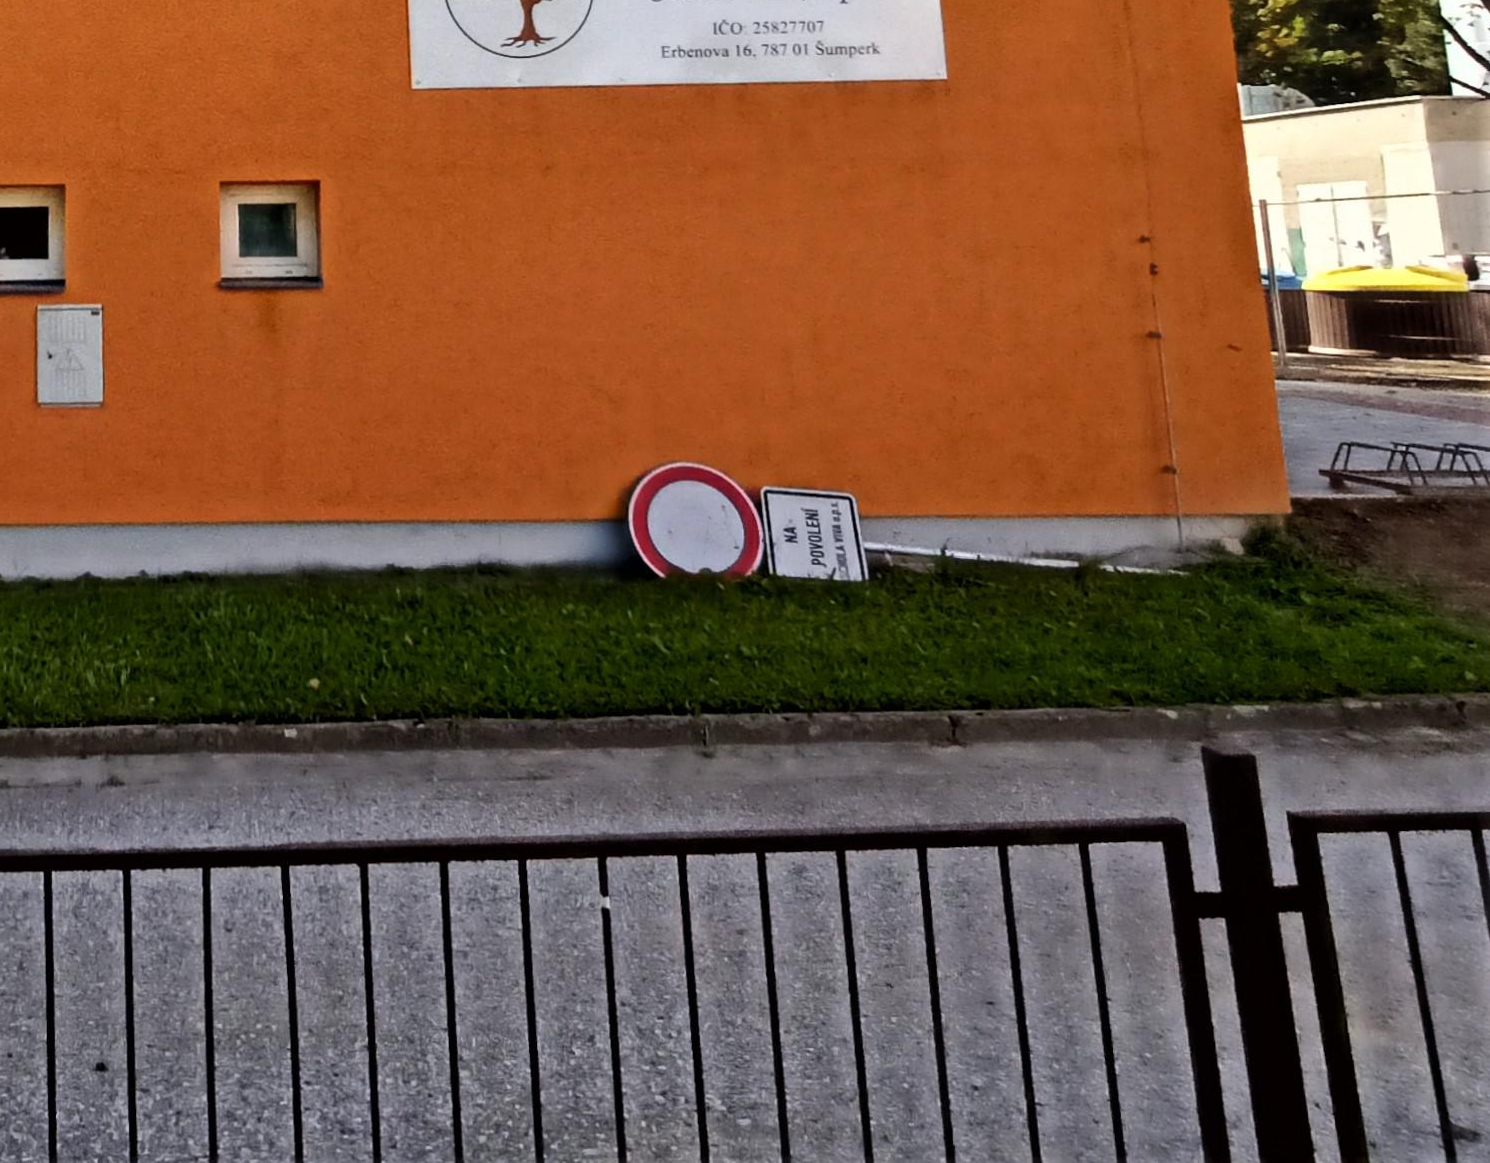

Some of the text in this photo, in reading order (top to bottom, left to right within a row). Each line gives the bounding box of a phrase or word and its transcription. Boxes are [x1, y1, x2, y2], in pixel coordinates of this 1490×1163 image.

[752, 20, 824, 35] 25827707
[661, 40, 881, 59] Erbenova 16, 787 01 Šumperk
[783, 526, 798, 544] NA
[801, 507, 827, 568] POVOLENÍ
